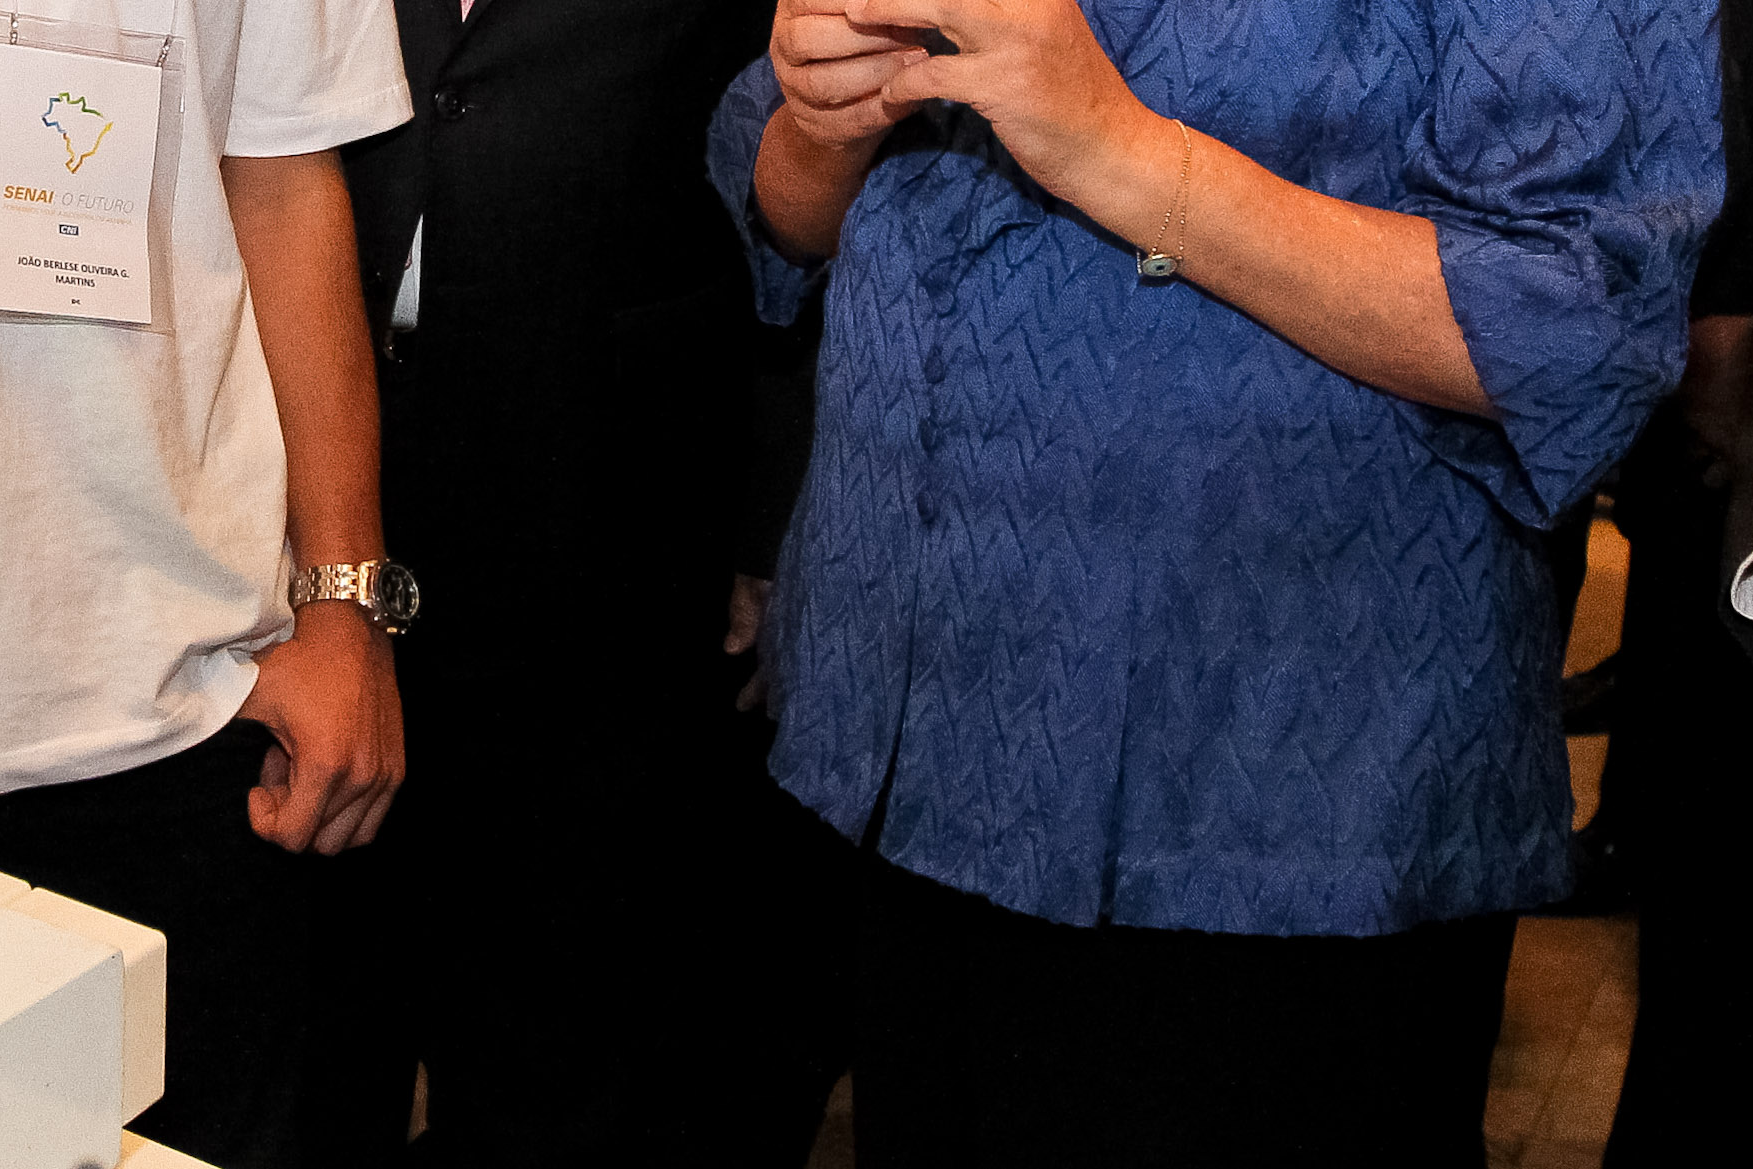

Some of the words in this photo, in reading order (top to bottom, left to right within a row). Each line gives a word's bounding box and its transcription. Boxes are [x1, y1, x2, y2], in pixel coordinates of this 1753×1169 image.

[62, 192, 74, 206] O
[77, 194, 135, 214] FUTURO
[60, 225, 78, 235] CNI
[17, 255, 42, 267] JOÃO
[43, 259, 79, 272] BERLESE
[80, 264, 120, 277] OLIVEIRA
[55, 275, 96, 288] MARTINS
